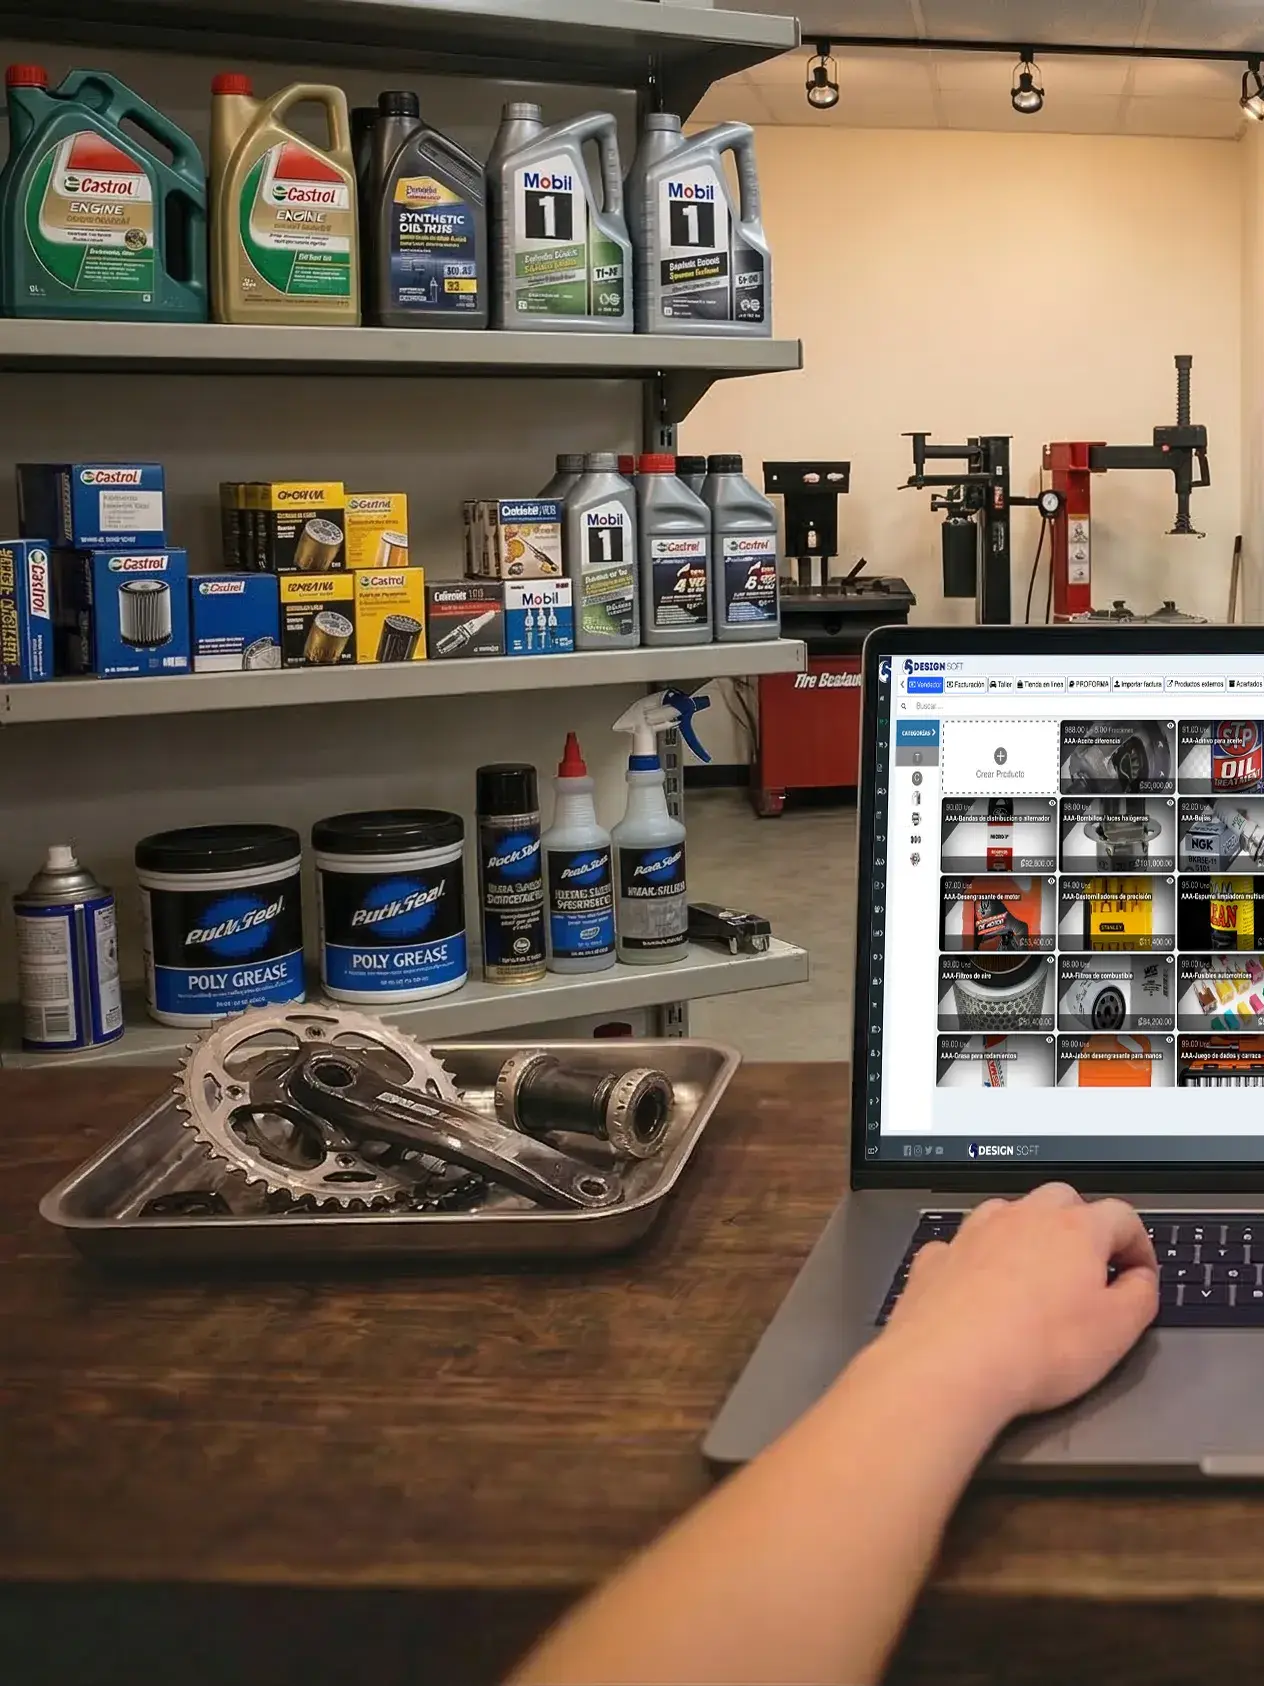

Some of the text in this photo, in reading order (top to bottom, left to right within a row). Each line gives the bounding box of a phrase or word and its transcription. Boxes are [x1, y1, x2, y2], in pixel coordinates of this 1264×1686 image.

[82, 178, 133, 195] Castrol
[524, 173, 572, 190] Mobil
[668, 183, 714, 200] Mobil
[70, 202, 124, 215] ENGINE
[538, 196, 556, 237] 1
[682, 205, 699, 244] 1
[95, 471, 138, 484] Castrol
[587, 514, 624, 526] Mobil
[597, 529, 612, 561] 1
[522, 592, 558, 606] Mobil
[914, 662, 963, 671] DESIGN SOFT
[1174, 680, 1200, 688] Productos
[976, 770, 1024, 778] Crear Producto
[1221, 757, 1256, 779] OIL
[1191, 839, 1213, 850] NGK
[352, 944, 448, 969] POLY GREASE
[188, 963, 288, 991] POLY GREASE
[978, 1145, 1040, 1155] DESIGN SOFT
